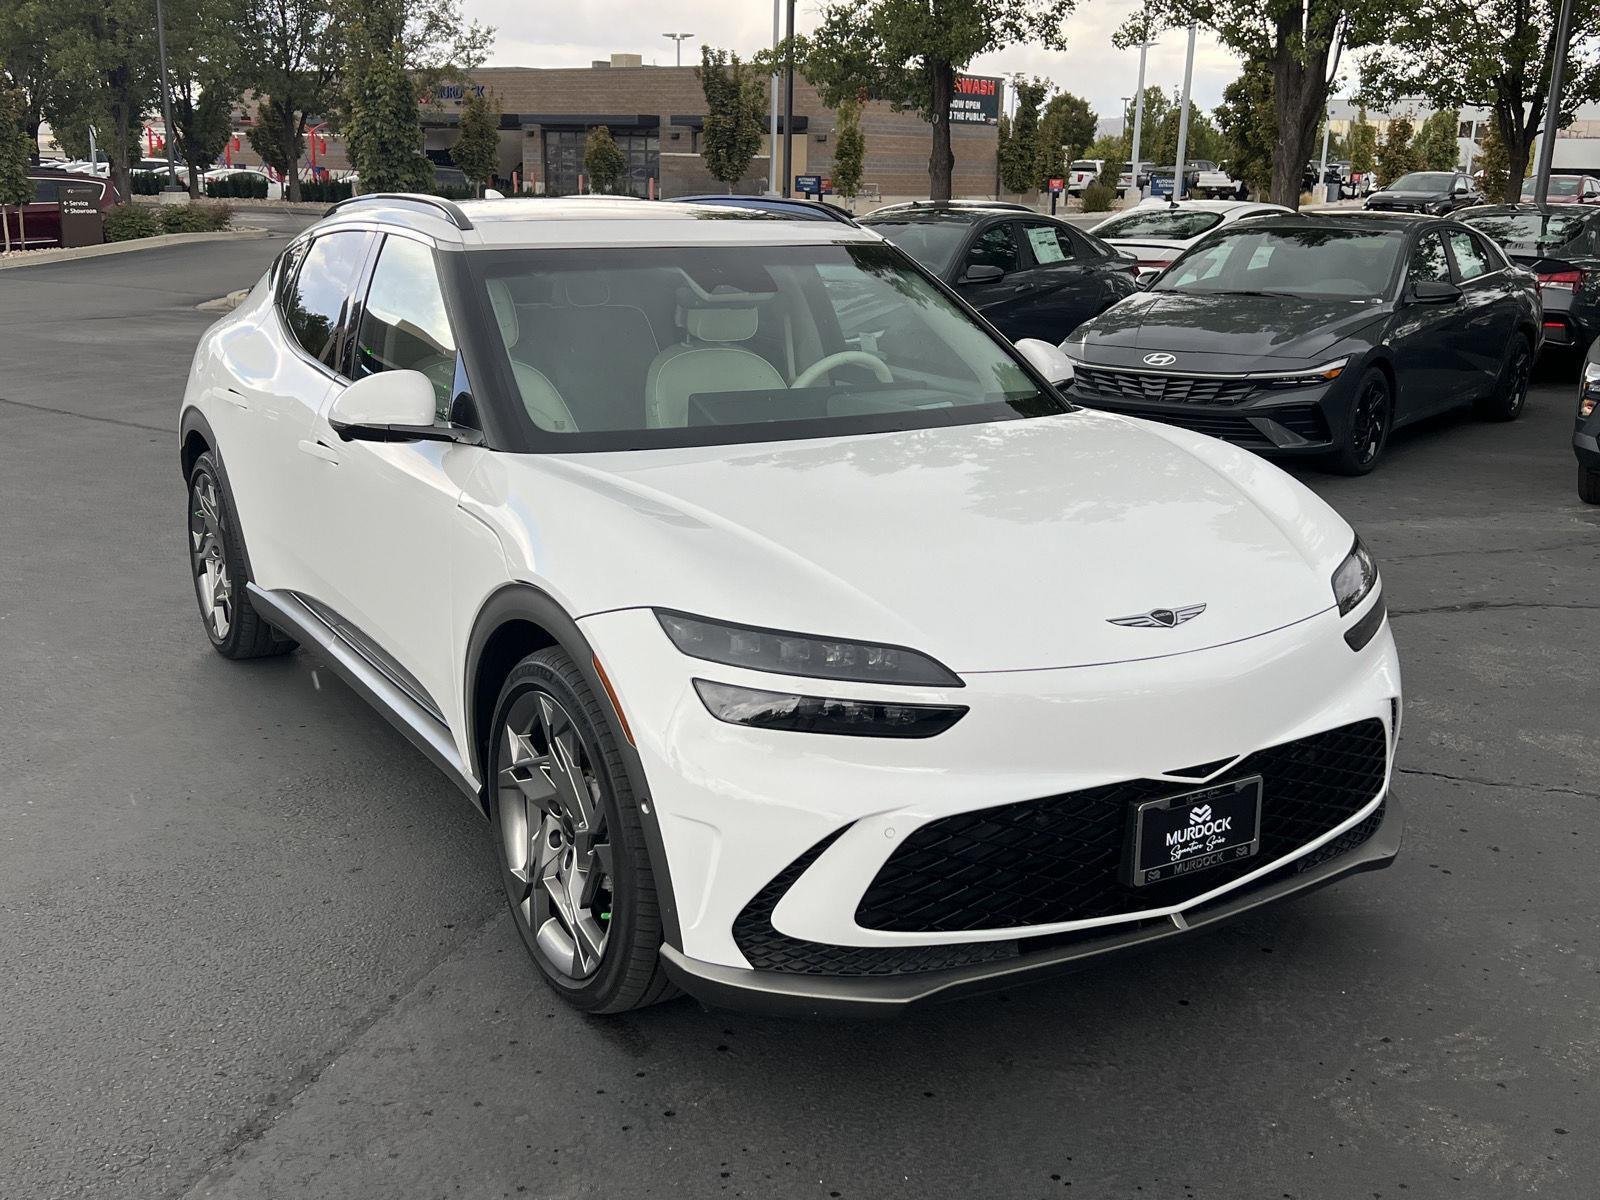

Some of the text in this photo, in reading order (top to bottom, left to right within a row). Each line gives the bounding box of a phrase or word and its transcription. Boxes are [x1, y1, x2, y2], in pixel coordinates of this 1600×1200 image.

[953, 111, 964, 120] THE
[965, 112, 986, 121] PUBLIC
[965, 101, 980, 109] OPEN
[1166, 816, 1232, 846] MURDOCK
[1170, 834, 1226, 861] Signature Series
[1174, 852, 1223, 874] MURDOCK
